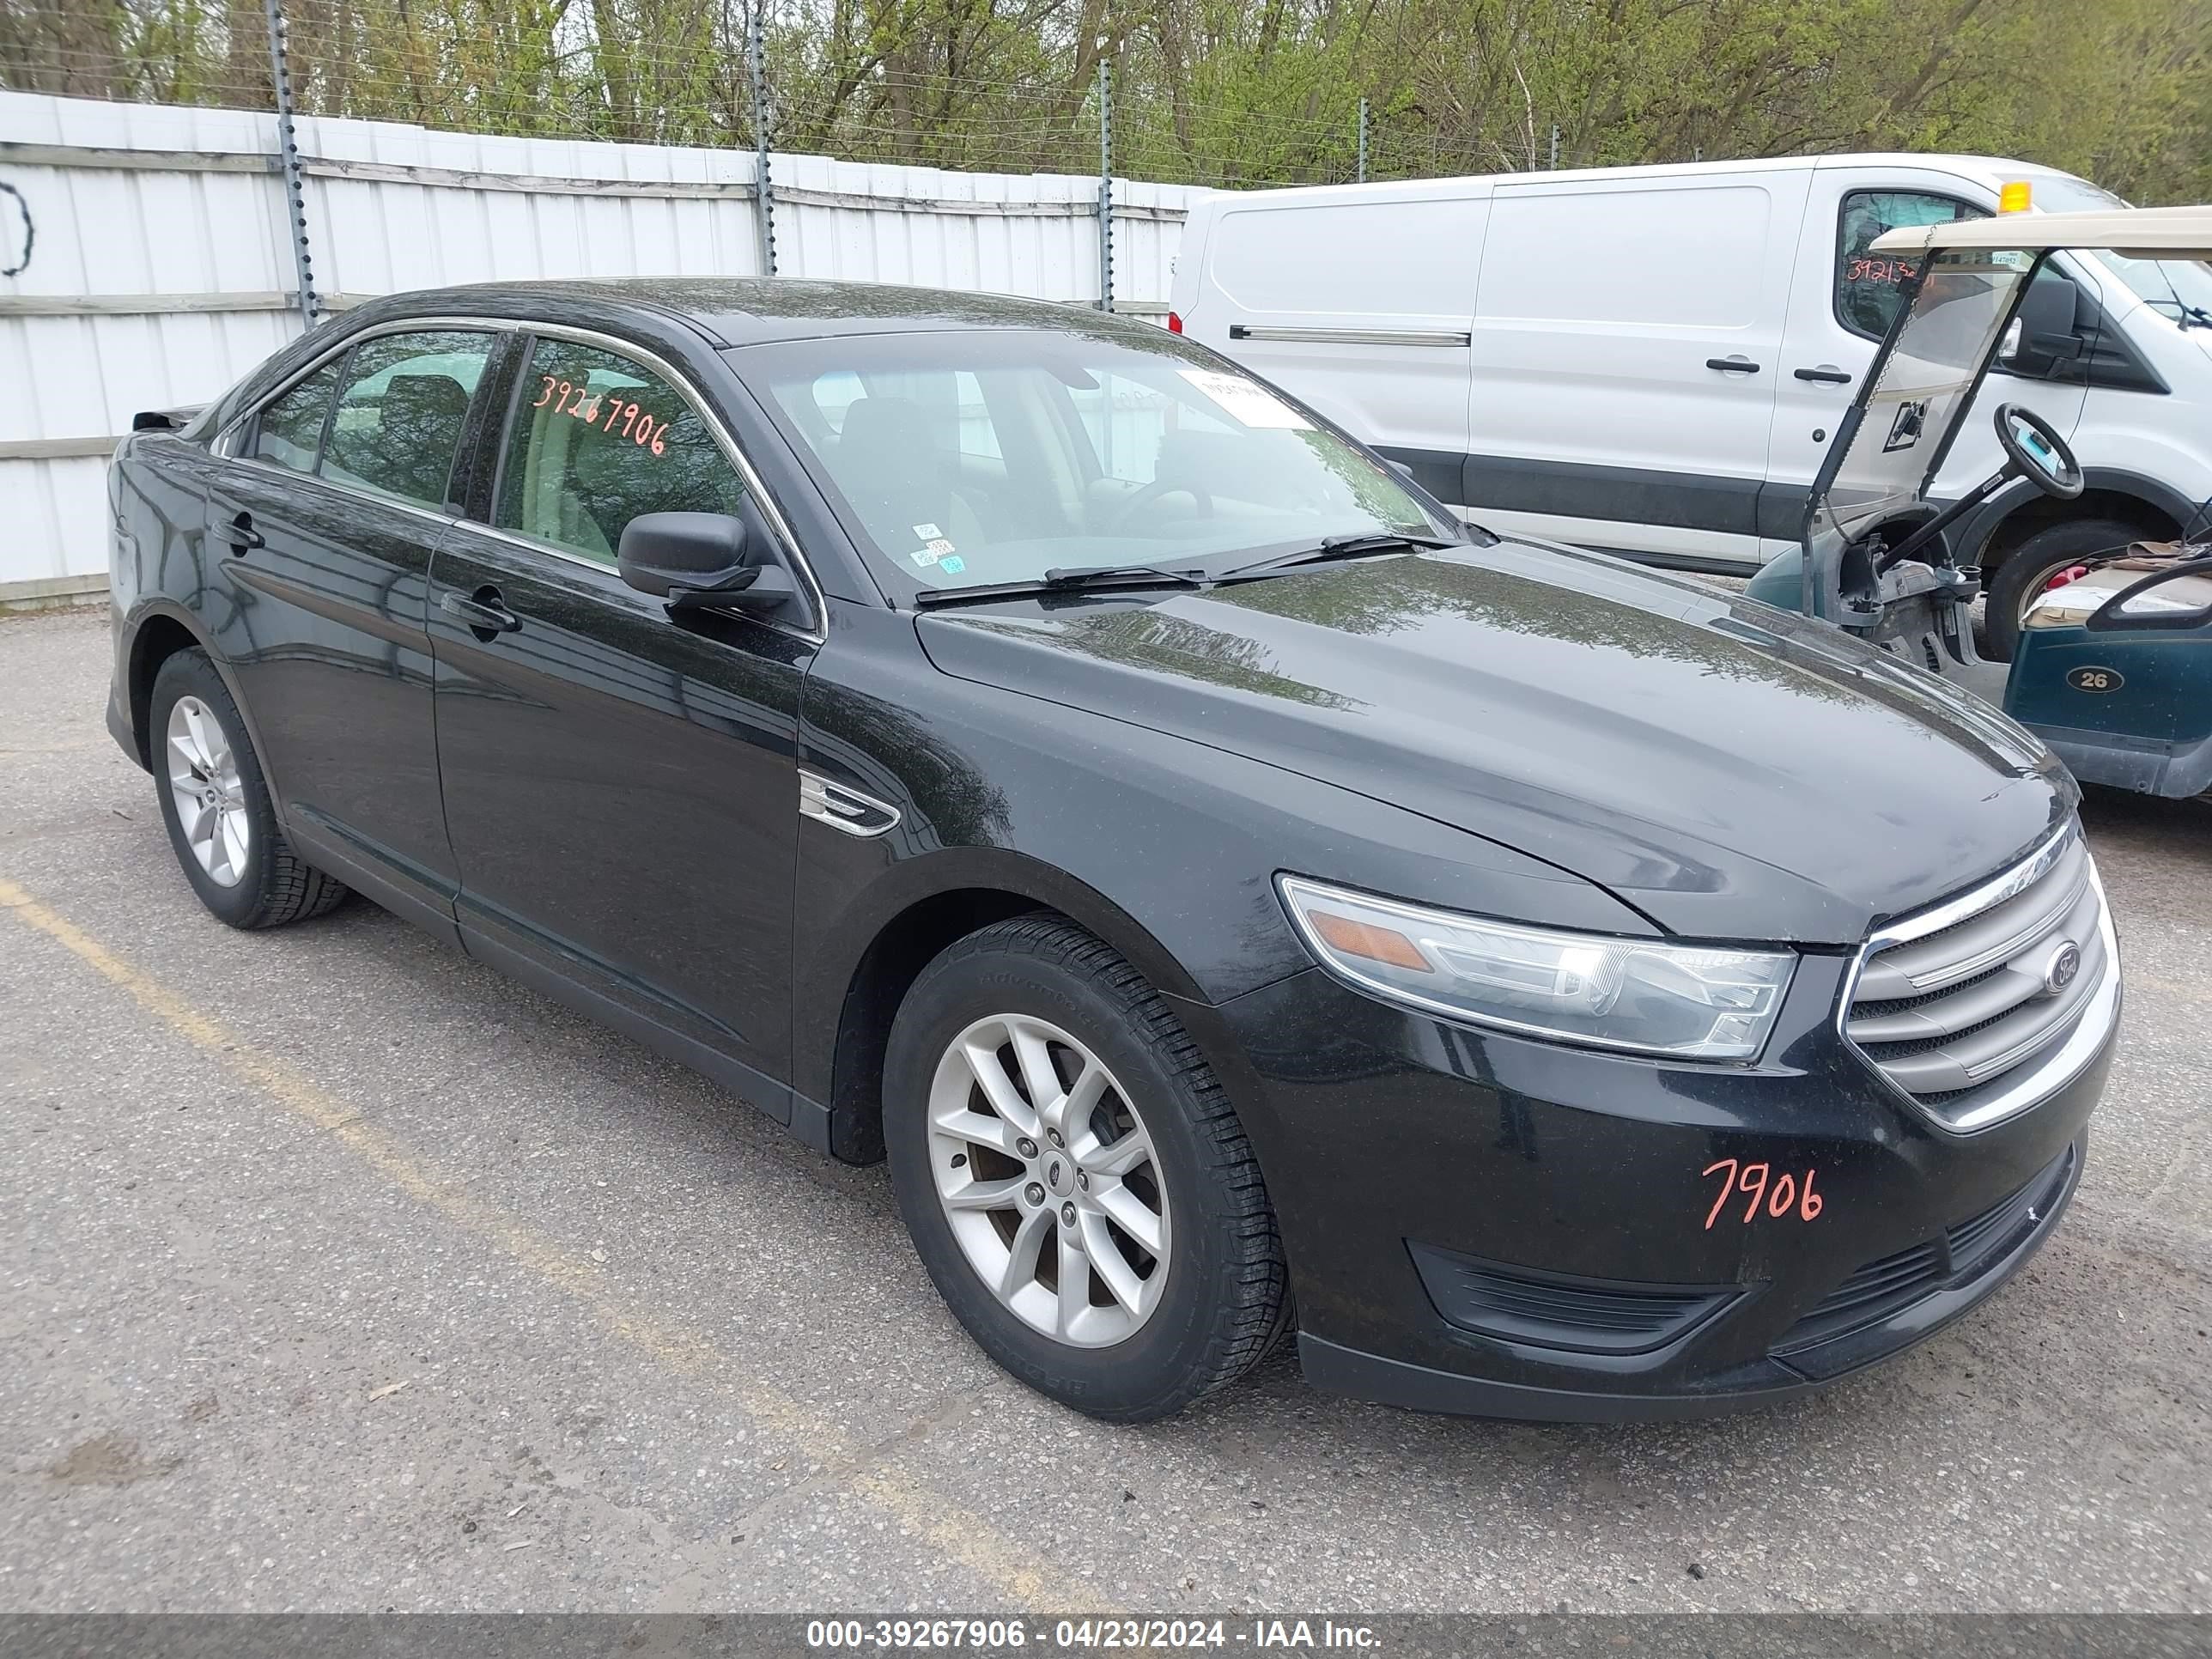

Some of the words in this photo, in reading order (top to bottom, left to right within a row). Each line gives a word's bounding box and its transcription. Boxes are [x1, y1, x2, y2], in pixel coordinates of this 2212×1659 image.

[532, 376, 669, 455] 39267906
[2081, 672, 2108, 689] 26
[2059, 953, 2077, 984] Ford
[1702, 1158, 1823, 1231] 7906
